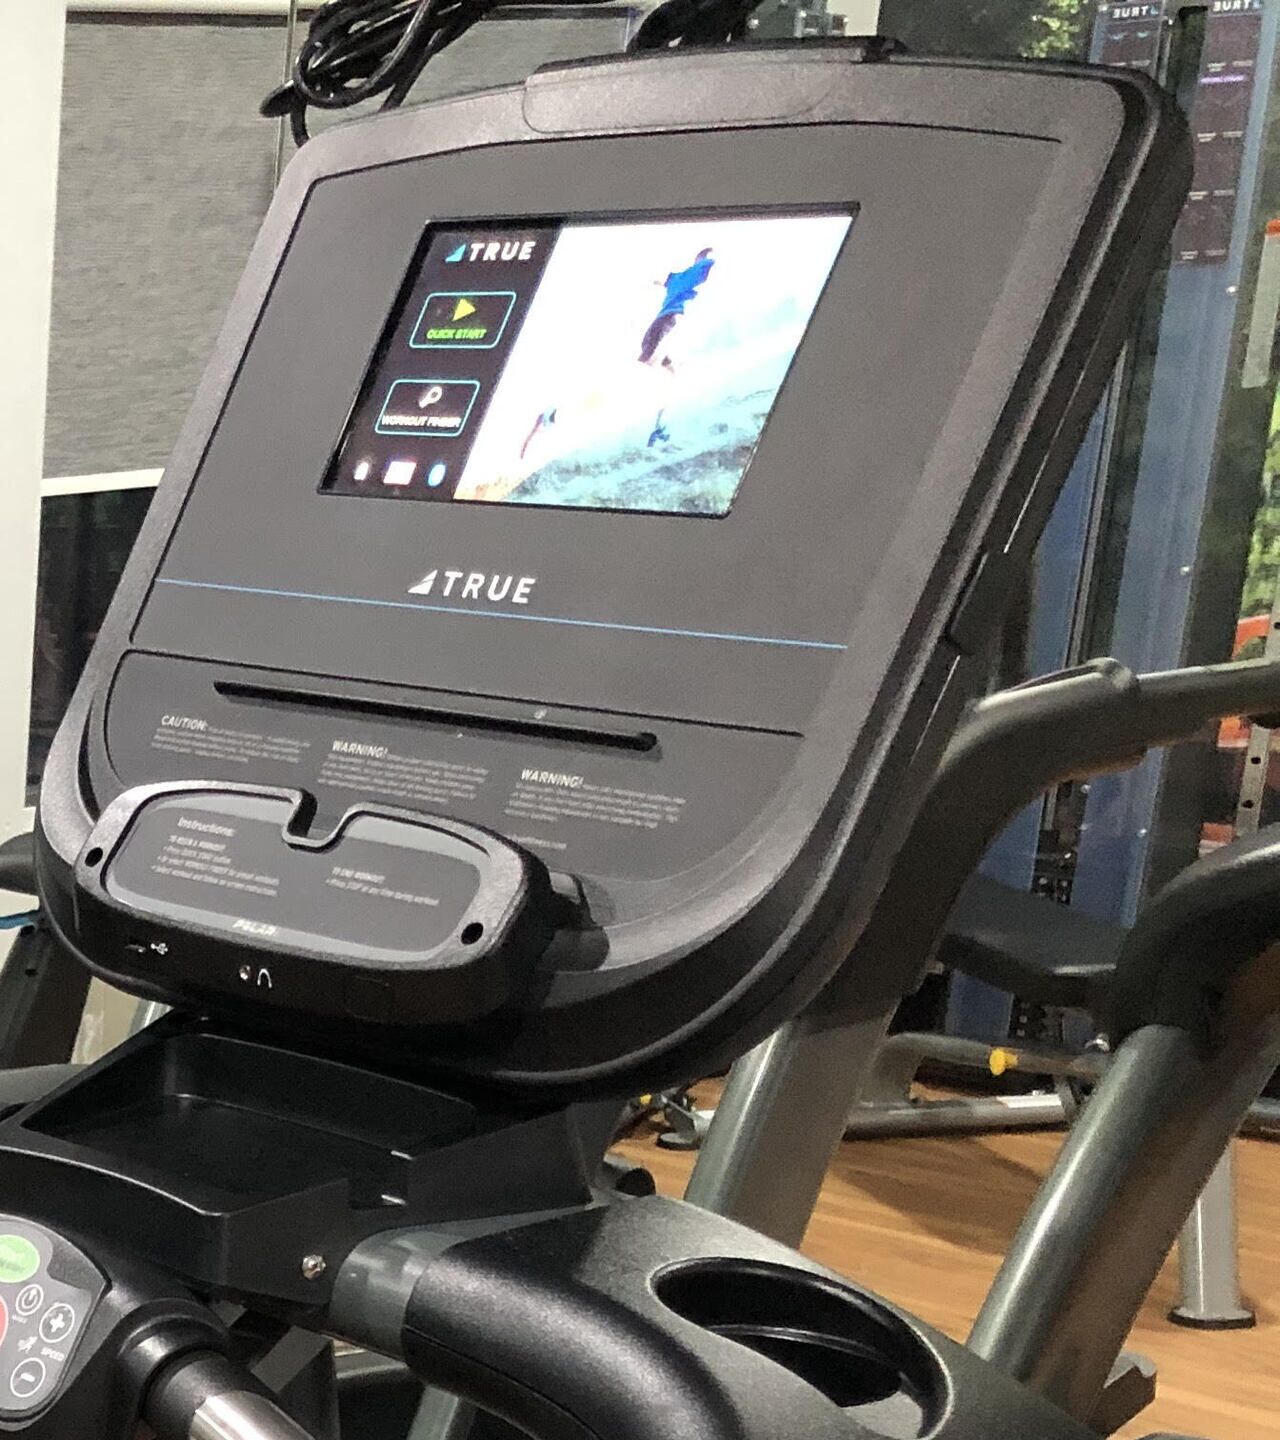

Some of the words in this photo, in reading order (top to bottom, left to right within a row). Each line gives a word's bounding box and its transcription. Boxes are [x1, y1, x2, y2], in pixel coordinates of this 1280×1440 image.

[469, 241, 536, 262] TRUE
[454, 328, 487, 340] START
[442, 571, 535, 603] TRUE
[332, 740, 388, 758] WARNING!
[521, 768, 584, 788] WARNING!
